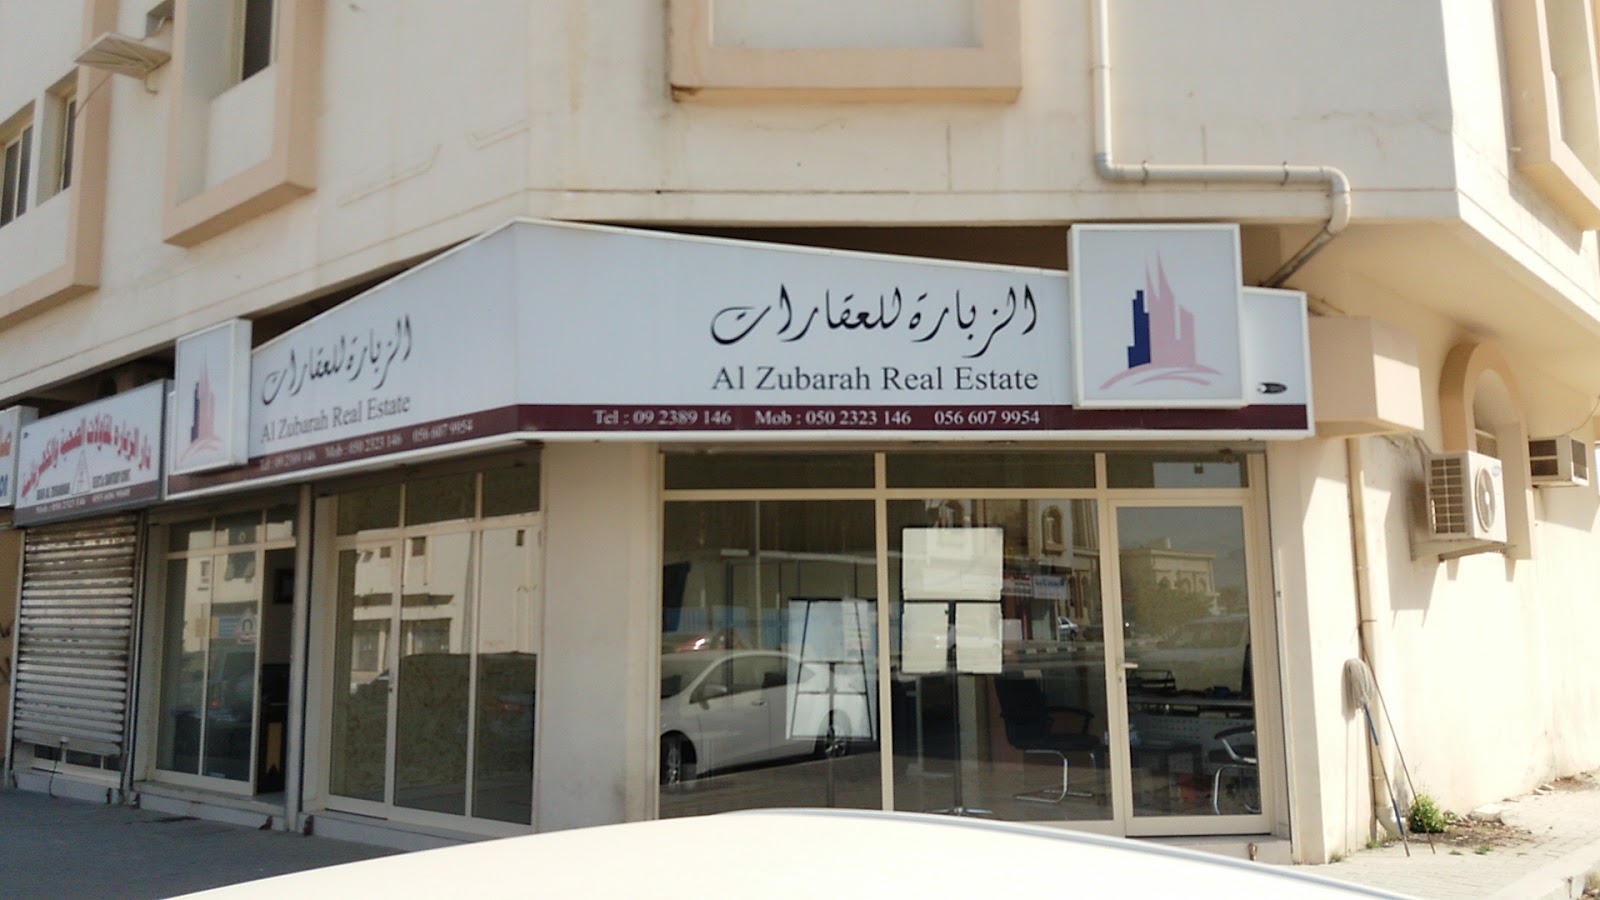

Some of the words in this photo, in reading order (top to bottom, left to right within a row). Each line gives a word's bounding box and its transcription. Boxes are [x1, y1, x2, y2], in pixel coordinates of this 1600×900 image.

[710, 284, 902, 345] للعقارات
[908, 284, 1037, 359] الزبارة
[262, 335, 347, 405] للعقارات
[712, 366, 745, 390] Al
[755, 366, 871, 391] Zubarah
[882, 366, 943, 391] Real
[954, 366, 1039, 391] Estate
[261, 422, 276, 444] Al
[277, 410, 329, 439] Zubarah
[333, 401, 364, 428] Real
[367, 396, 411, 421] Estate
[592, 409, 619, 426] Tel
[632, 409, 655, 426] 09
[657, 409, 699, 426] 2389
[703, 409, 732, 426] 146
[755, 410, 792, 426] Mob
[805, 410, 836, 426] 050
[839, 410, 878, 426] 2323
[884, 410, 912, 426] 146
[934, 410, 964, 426] 056
[967, 410, 997, 426] 607
[1001, 410, 1040, 426] 9954
